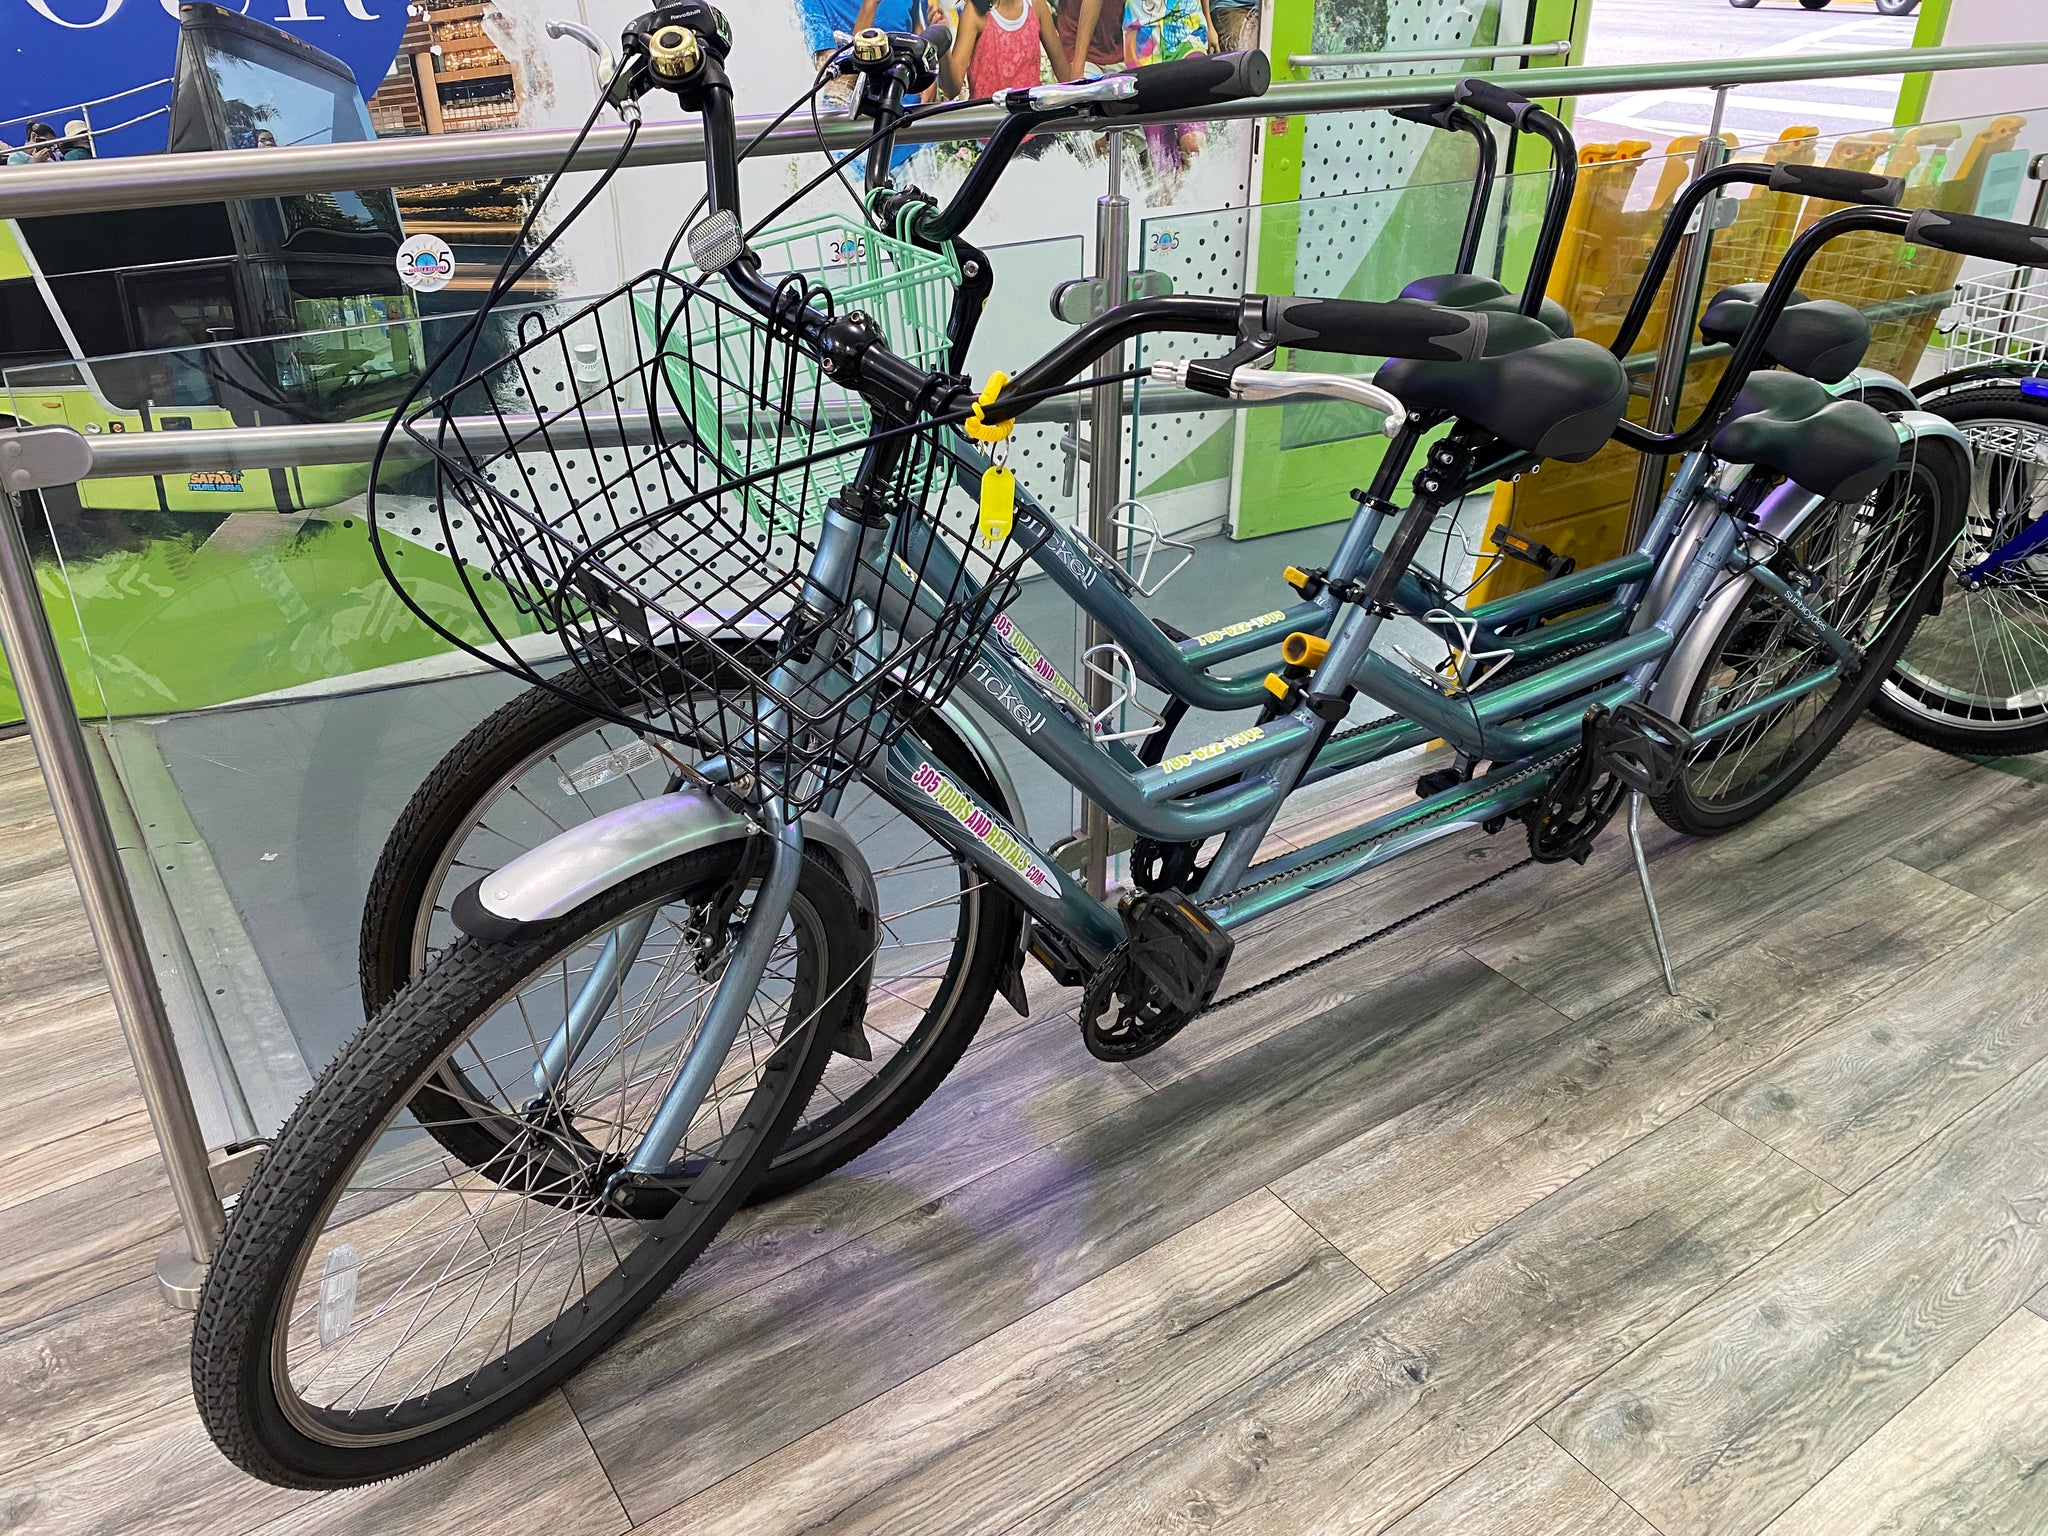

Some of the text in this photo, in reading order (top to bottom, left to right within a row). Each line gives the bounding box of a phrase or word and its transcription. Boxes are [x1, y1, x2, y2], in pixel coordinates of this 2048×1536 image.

[400, 251, 451, 276] 305
[190, 472, 239, 484] SAFARI
[1784, 590, 1827, 632] sunbicycles
[960, 652, 1047, 736] rickell
